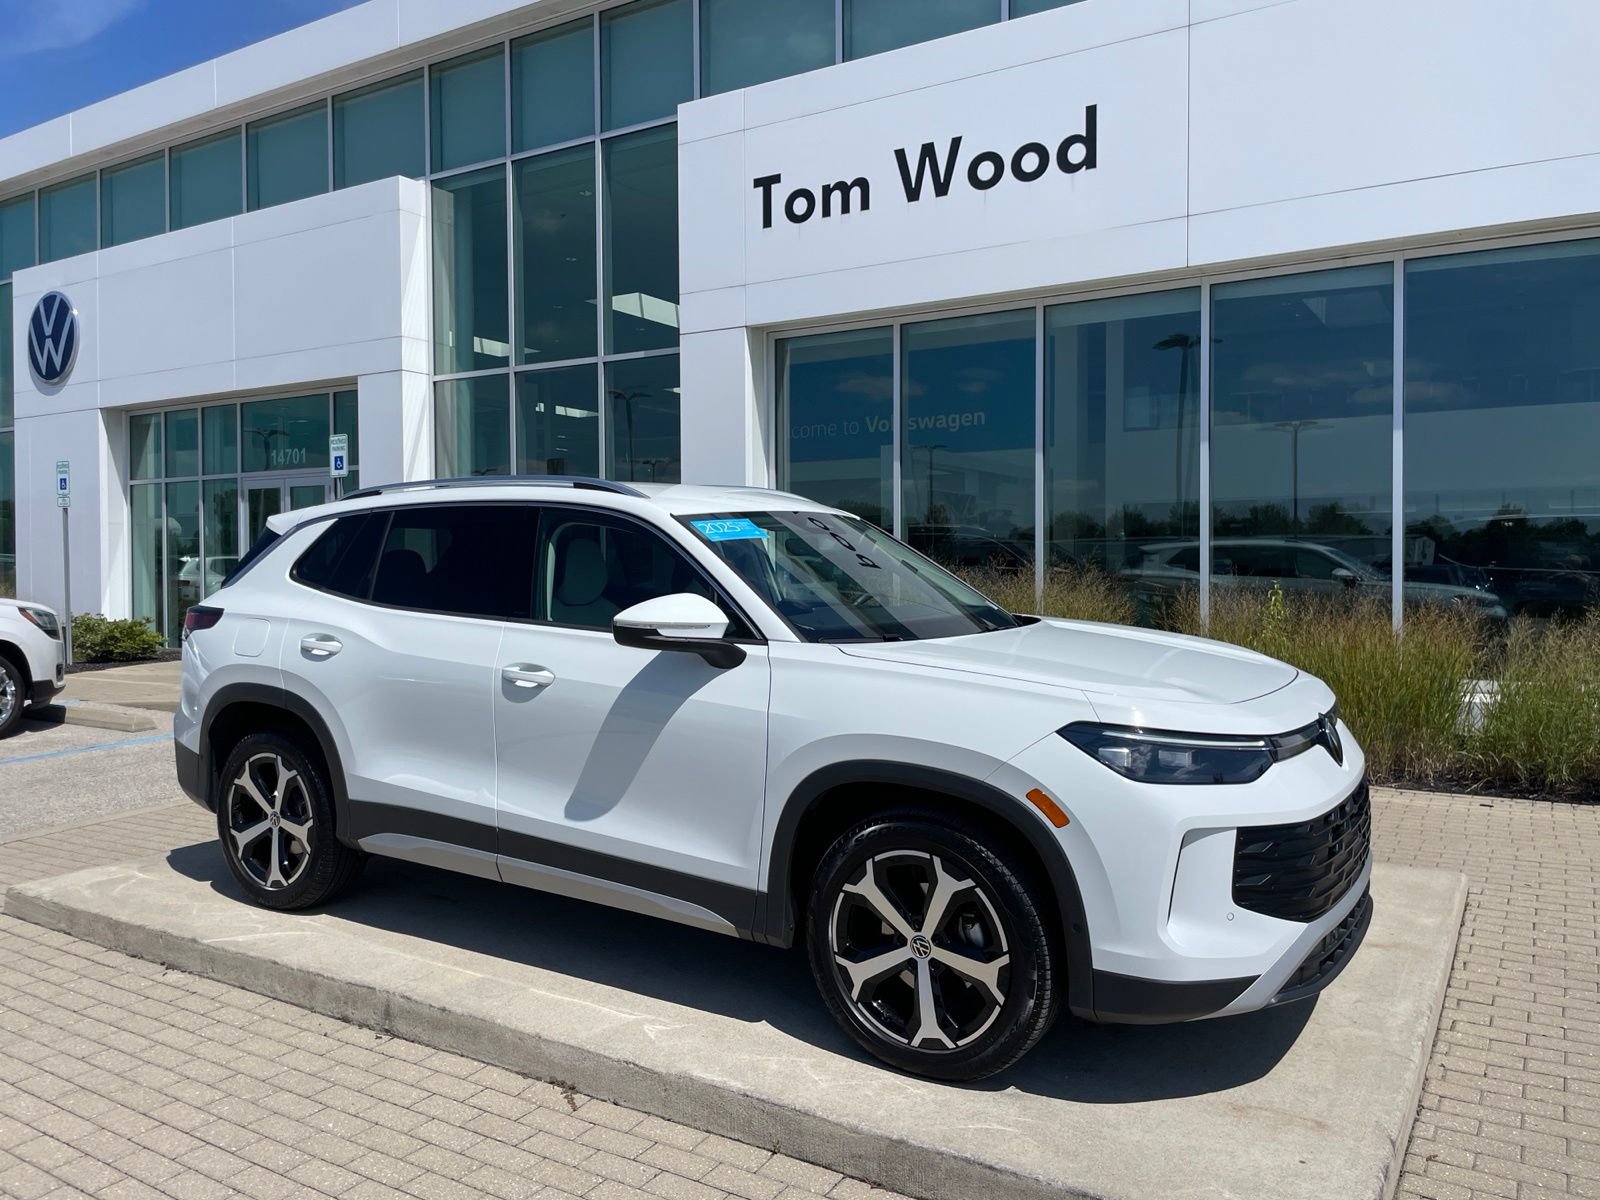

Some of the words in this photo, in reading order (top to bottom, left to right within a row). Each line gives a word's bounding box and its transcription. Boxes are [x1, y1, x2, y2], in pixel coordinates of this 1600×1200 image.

[753, 173, 870, 229] Tom
[893, 104, 1097, 203] Wood
[29, 293, 76, 377] VW
[791, 423, 838, 439] come
[843, 421, 860, 436] to
[864, 411, 985, 433] Volswagen
[271, 447, 306, 465] 14701
[698, 521, 741, 534] 2025
